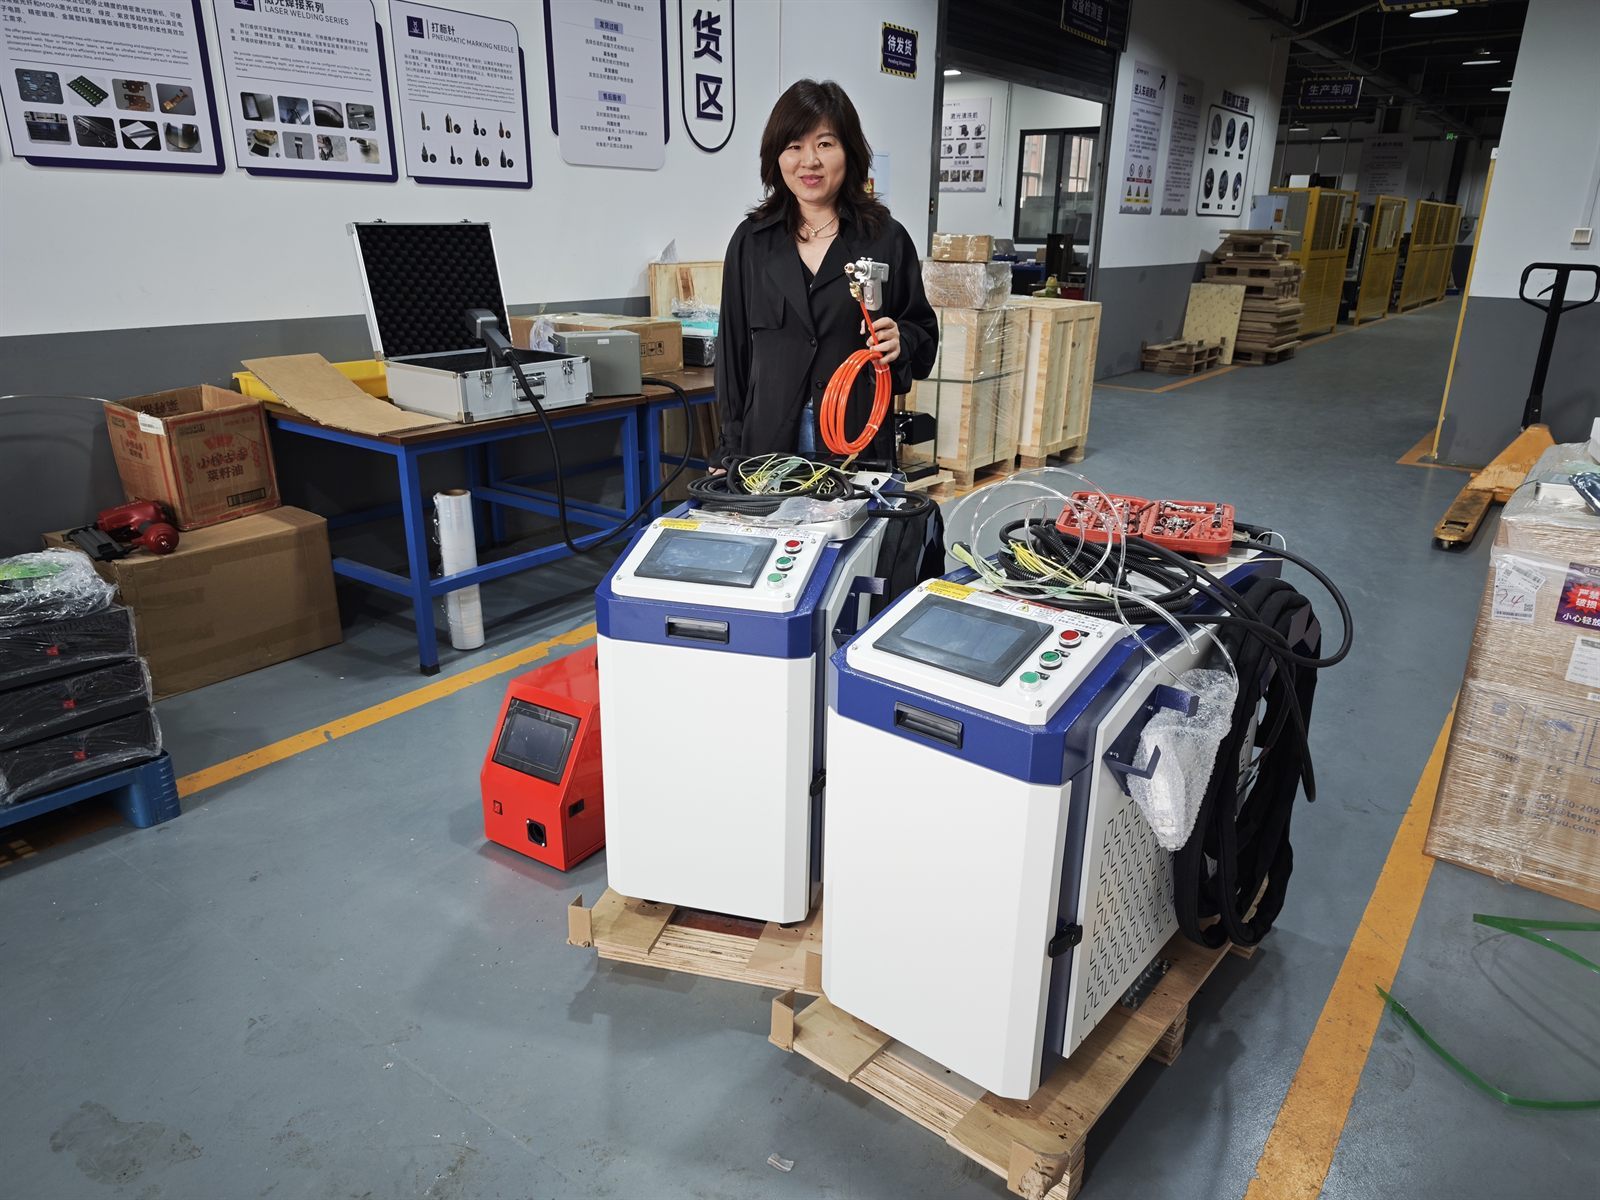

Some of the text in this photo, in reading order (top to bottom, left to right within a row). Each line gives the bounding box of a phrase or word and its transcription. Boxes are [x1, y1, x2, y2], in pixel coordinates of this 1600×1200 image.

[265, 5, 349, 26] LASER WELDING SERIES
[431, 22, 455, 36] 打标针
[432, 34, 514, 54] PNEUMATIC MARKING NEEDLE
[887, 34, 913, 56] 待发货
[1308, 84, 1353, 96] 生产车间
[206, 463, 244, 483] 菜籽油
[1575, 598, 1598, 609] 破损
[1562, 612, 1600, 627] 小心轻放
